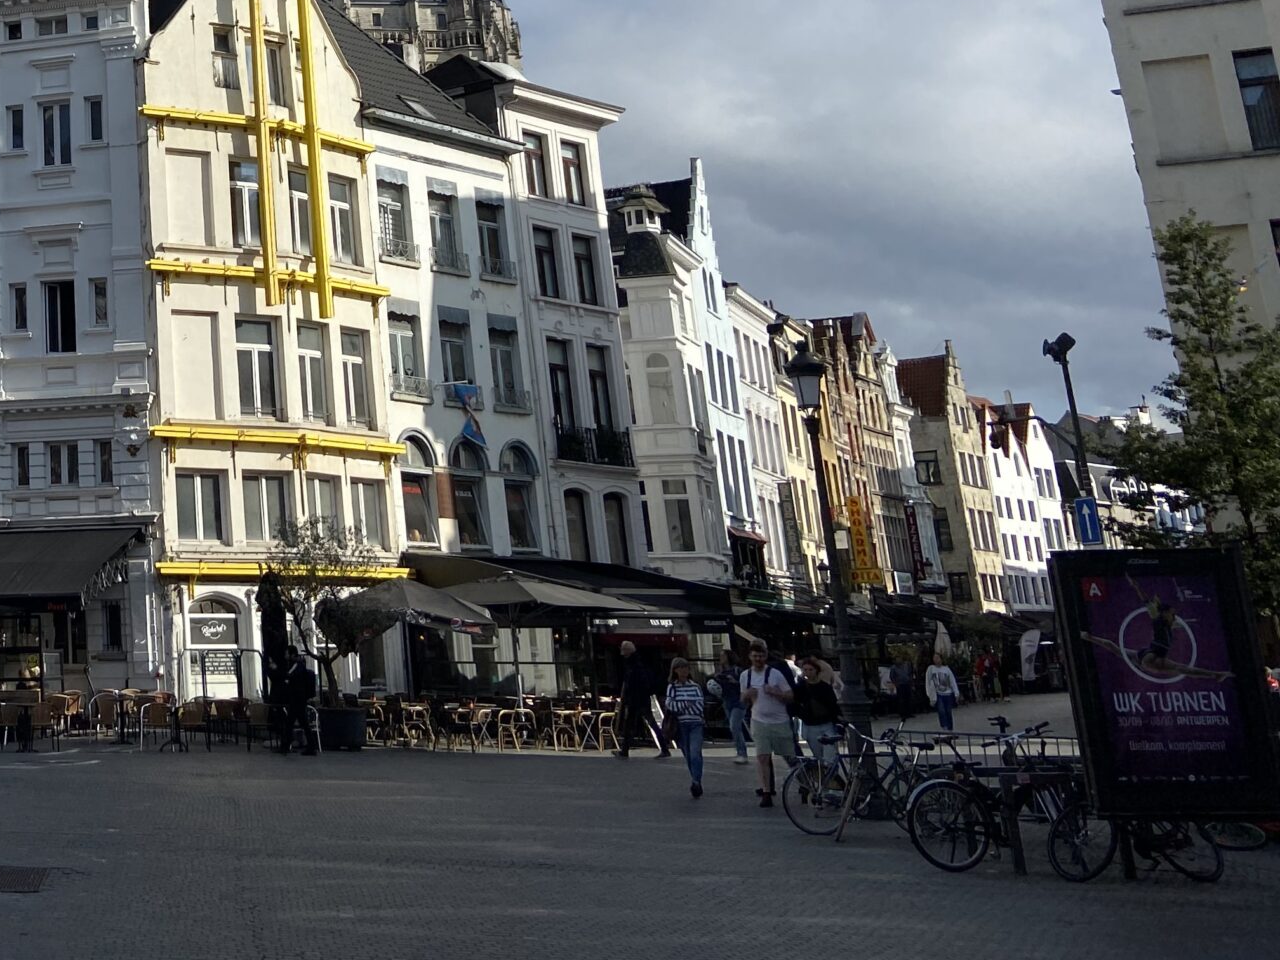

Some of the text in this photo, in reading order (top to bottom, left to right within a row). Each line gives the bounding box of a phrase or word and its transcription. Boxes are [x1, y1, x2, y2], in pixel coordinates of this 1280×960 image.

[850, 498, 868, 567] SHOARMA
[906, 506, 924, 579] PIZZERIA
[851, 571, 880, 581] PITA
[1088, 582, 1102, 597] A
[1113, 691, 1227, 713] WK TURNEN
[1176, 715, 1231, 726] ANTWERPEN
